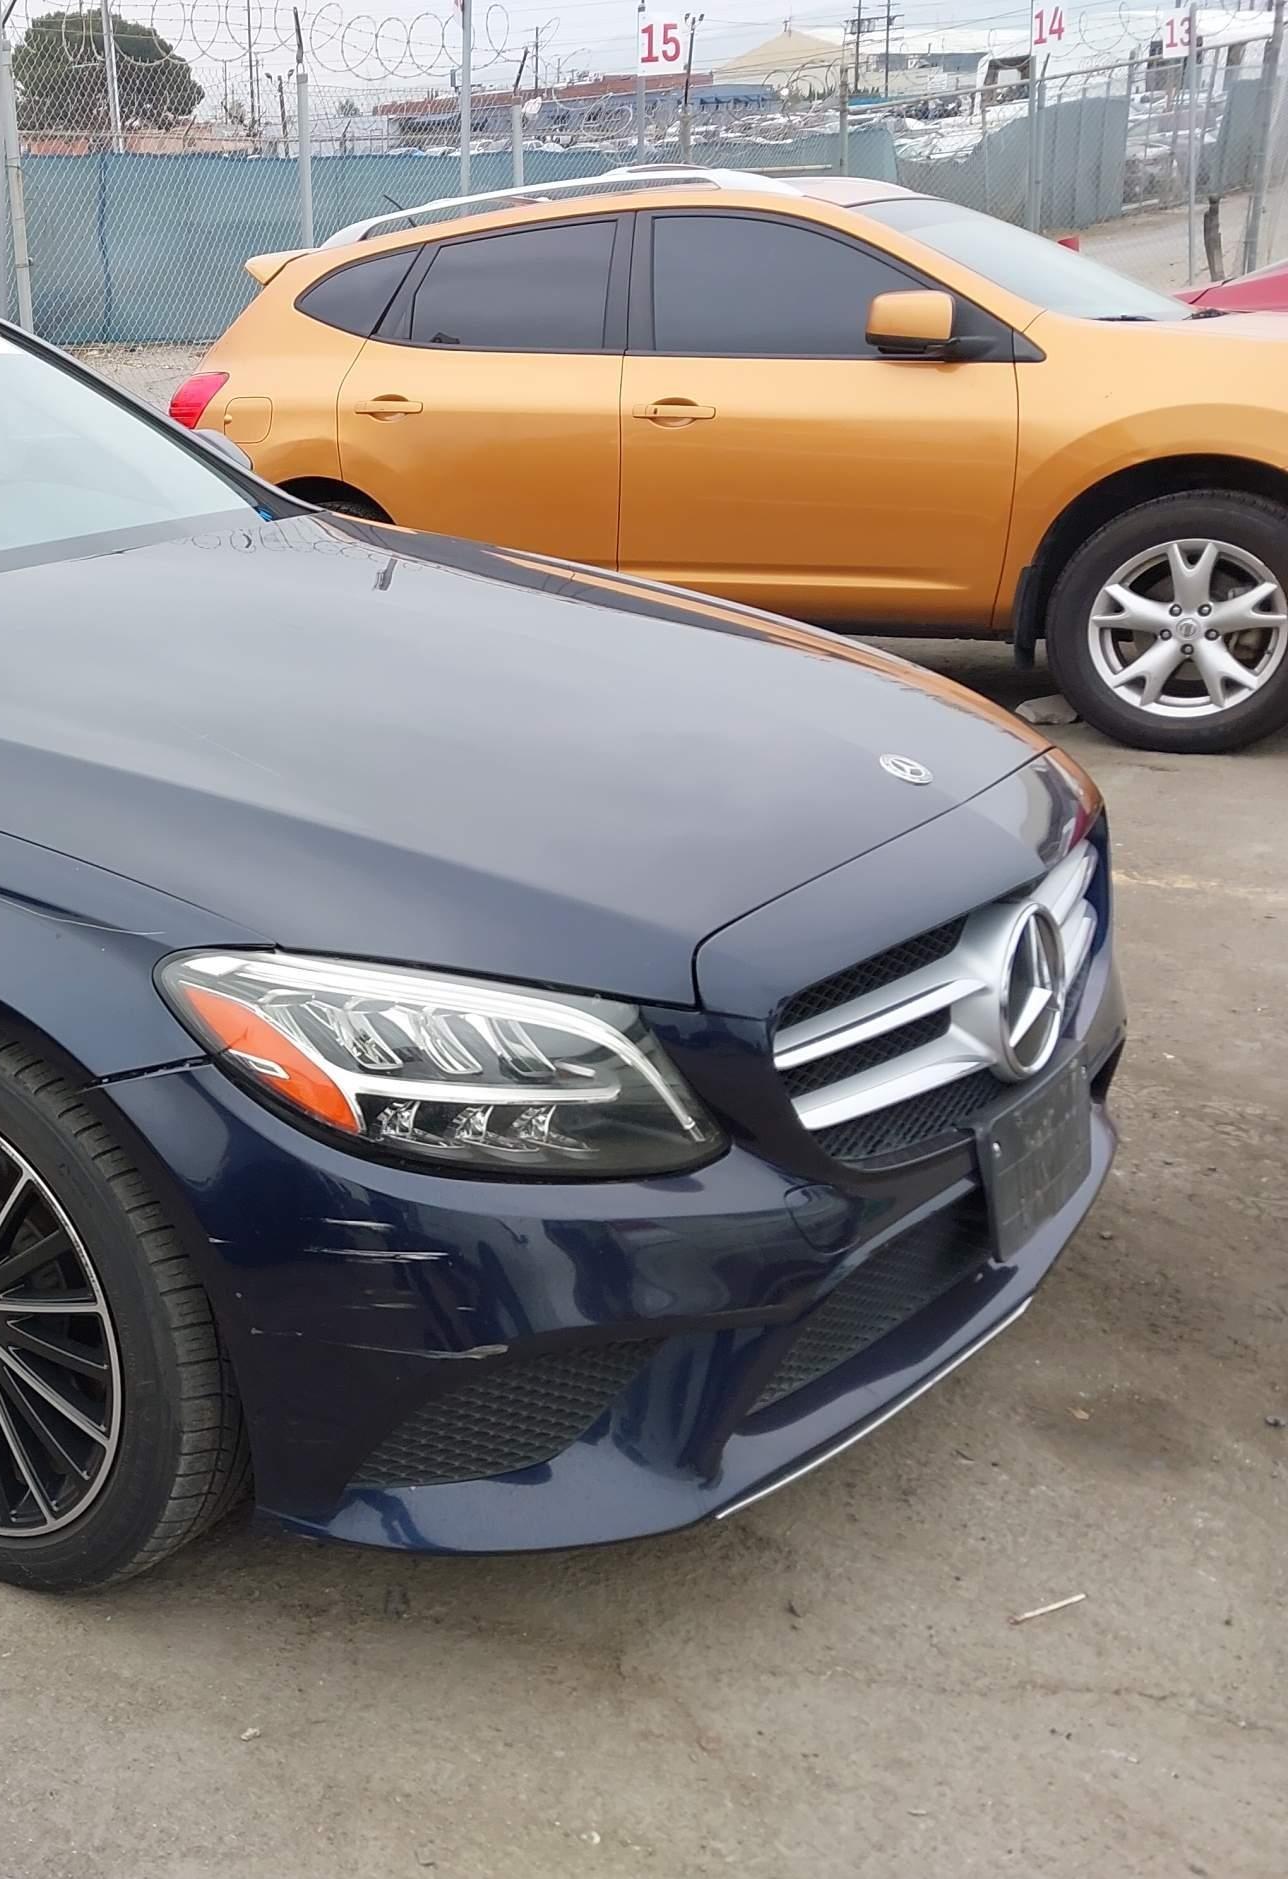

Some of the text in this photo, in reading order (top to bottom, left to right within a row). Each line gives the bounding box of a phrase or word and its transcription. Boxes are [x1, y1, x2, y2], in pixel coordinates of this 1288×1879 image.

[640, 23, 681, 63] 15
[1033, 6, 1065, 45] 14
[1165, 16, 1192, 48] 13
